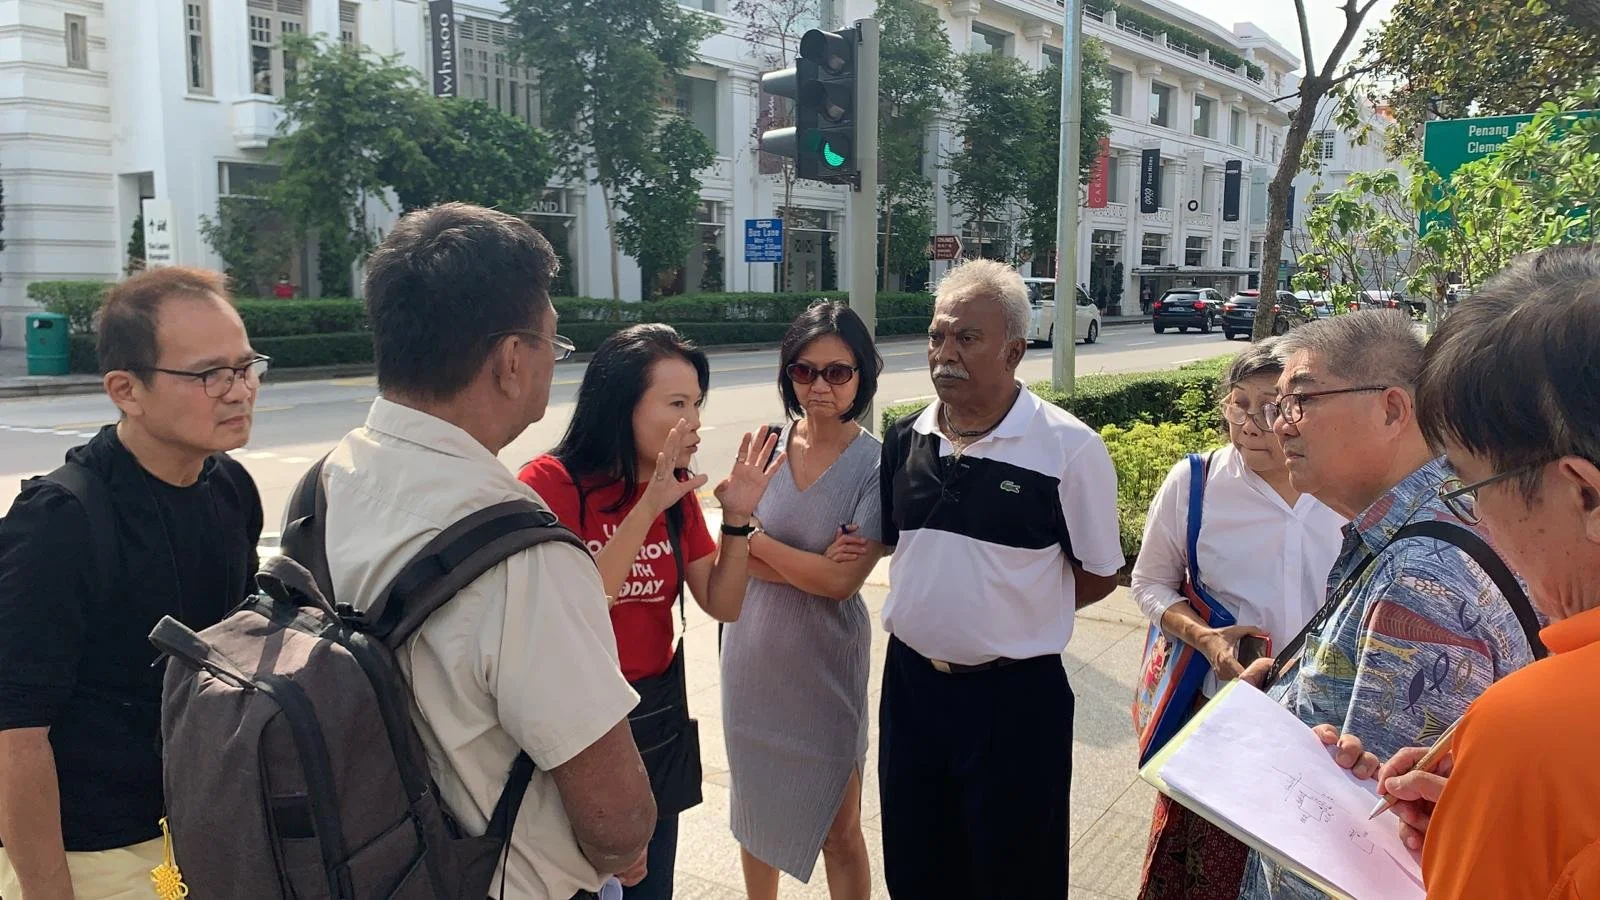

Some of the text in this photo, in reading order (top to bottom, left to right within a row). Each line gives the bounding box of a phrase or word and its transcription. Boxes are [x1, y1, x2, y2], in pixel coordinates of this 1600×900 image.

[438, 13, 453, 98] lwhasoo
[1468, 124, 1509, 137] Penang
[1467, 142, 1502, 154] Cleme
[632, 562, 656, 578] ITH
[619, 579, 665, 597] ODAY
